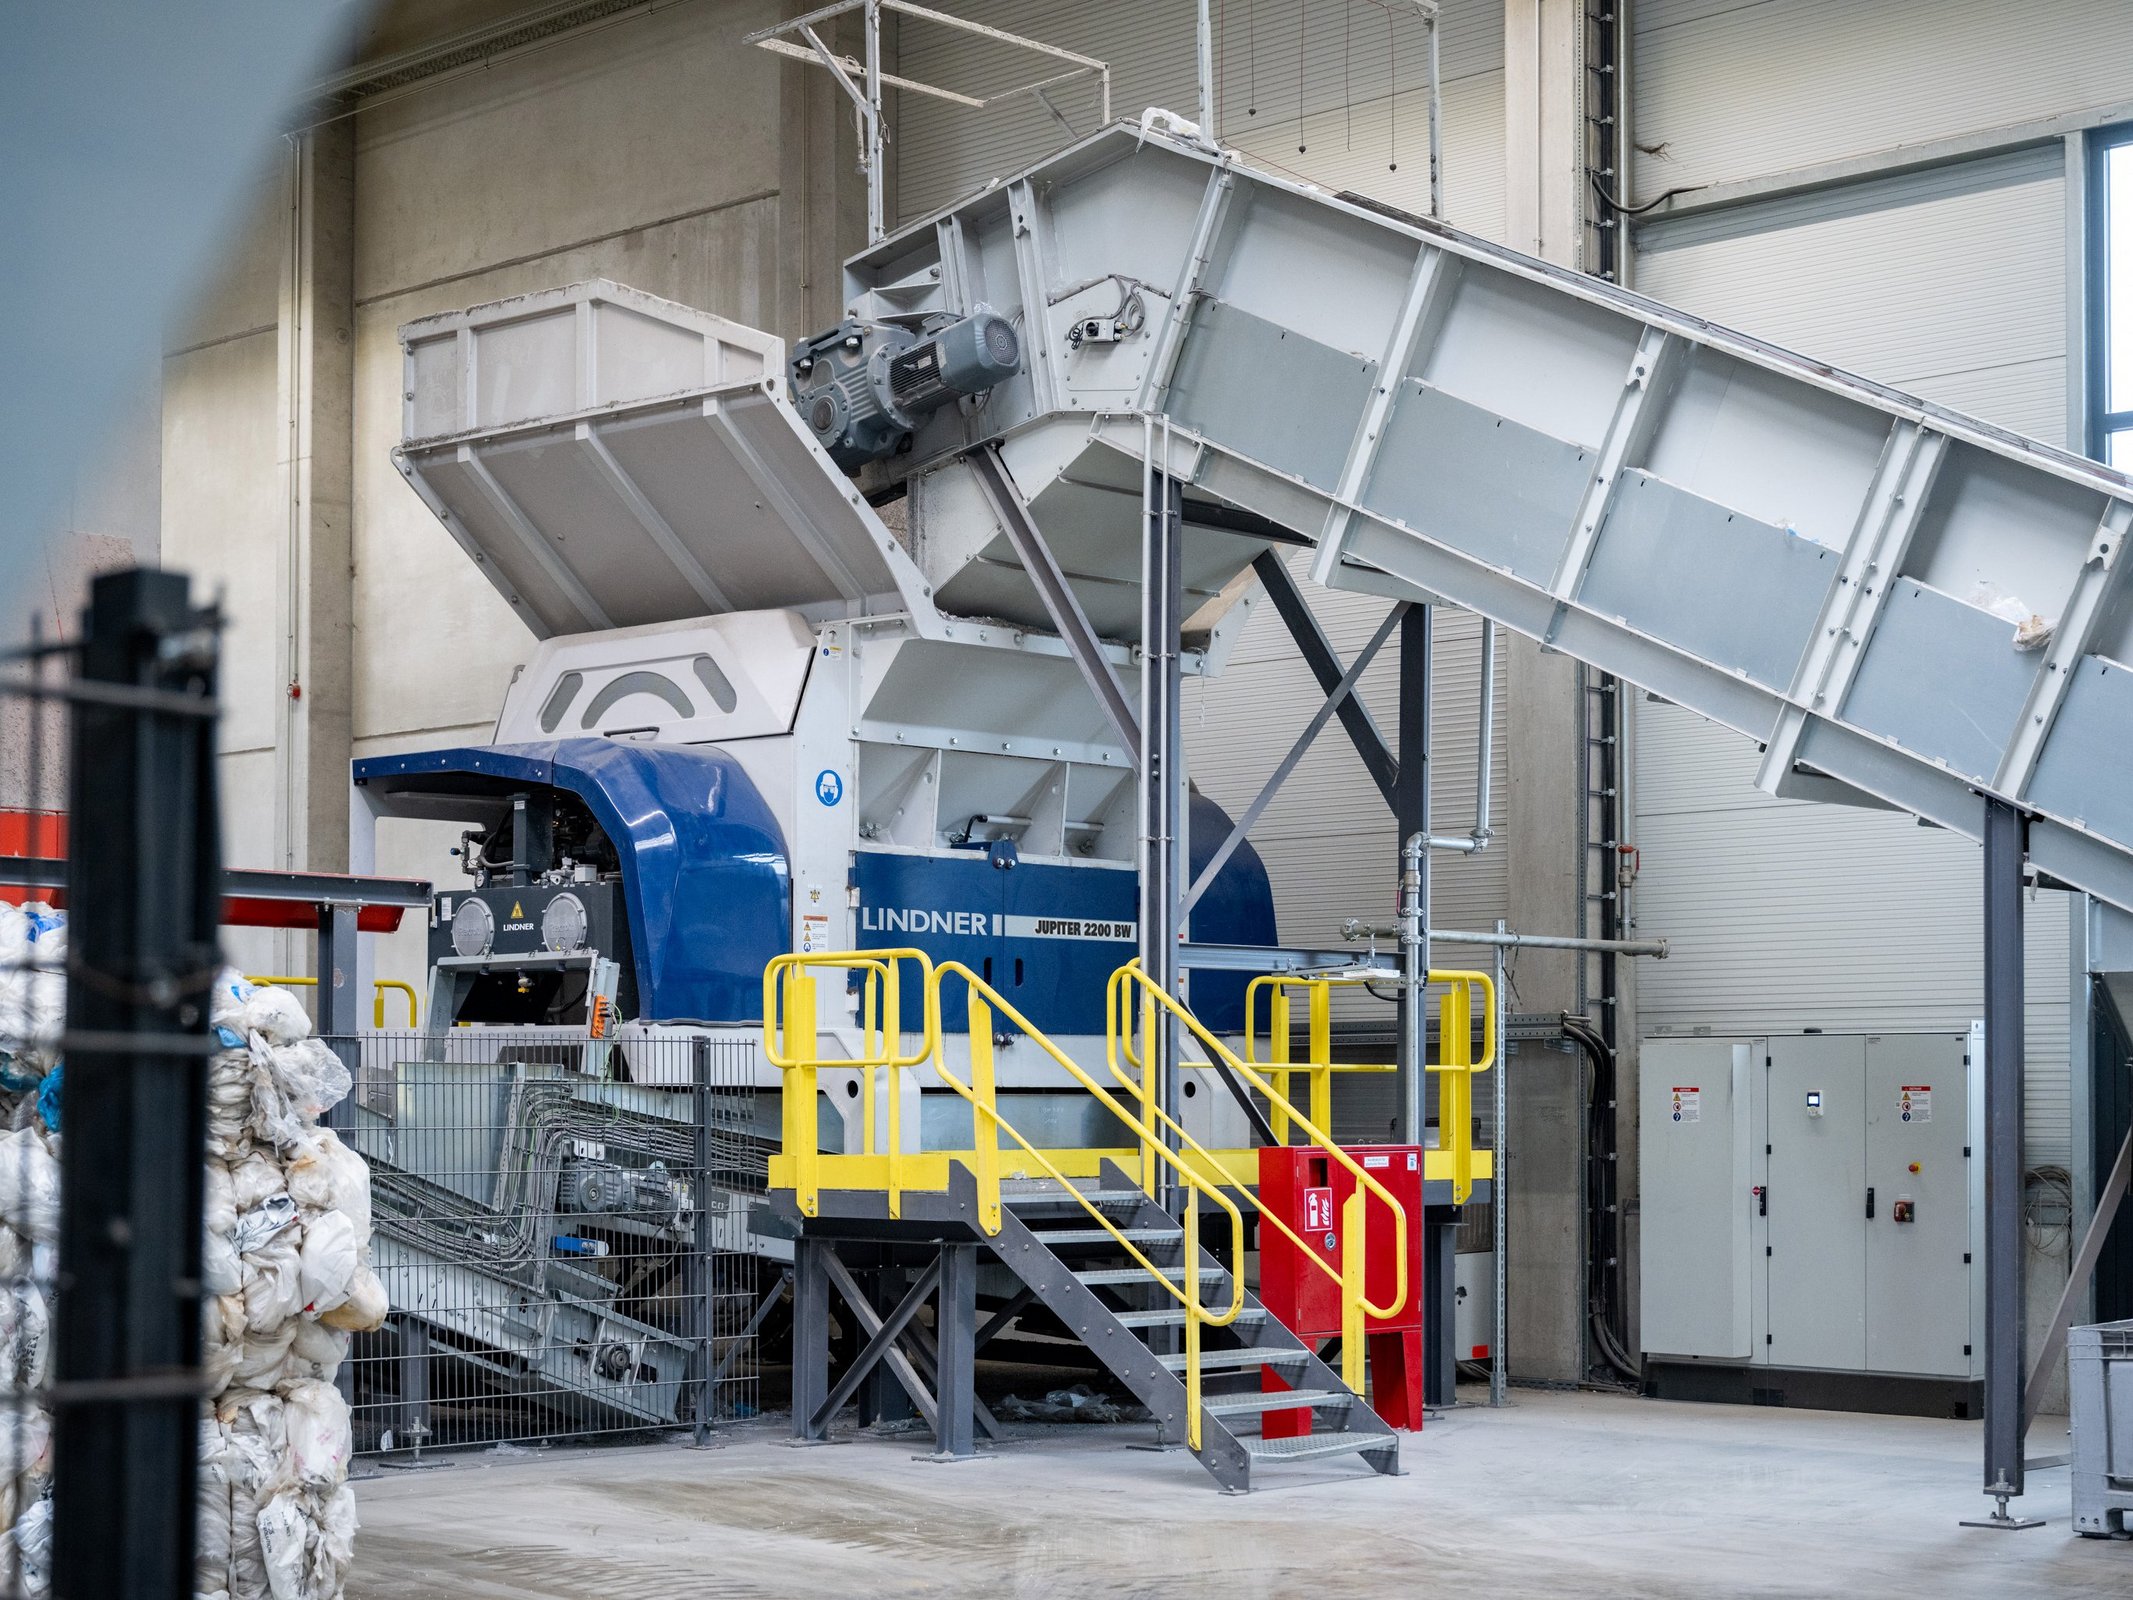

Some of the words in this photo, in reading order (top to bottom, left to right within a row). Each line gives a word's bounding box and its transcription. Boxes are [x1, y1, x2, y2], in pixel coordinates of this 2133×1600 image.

[503, 923, 534, 931] LINDNER
[863, 907, 987, 936] LINDNER
[1035, 919, 1081, 936] JUPITER
[1084, 923, 1112, 937] 2200
[1114, 924, 1132, 938] BW
